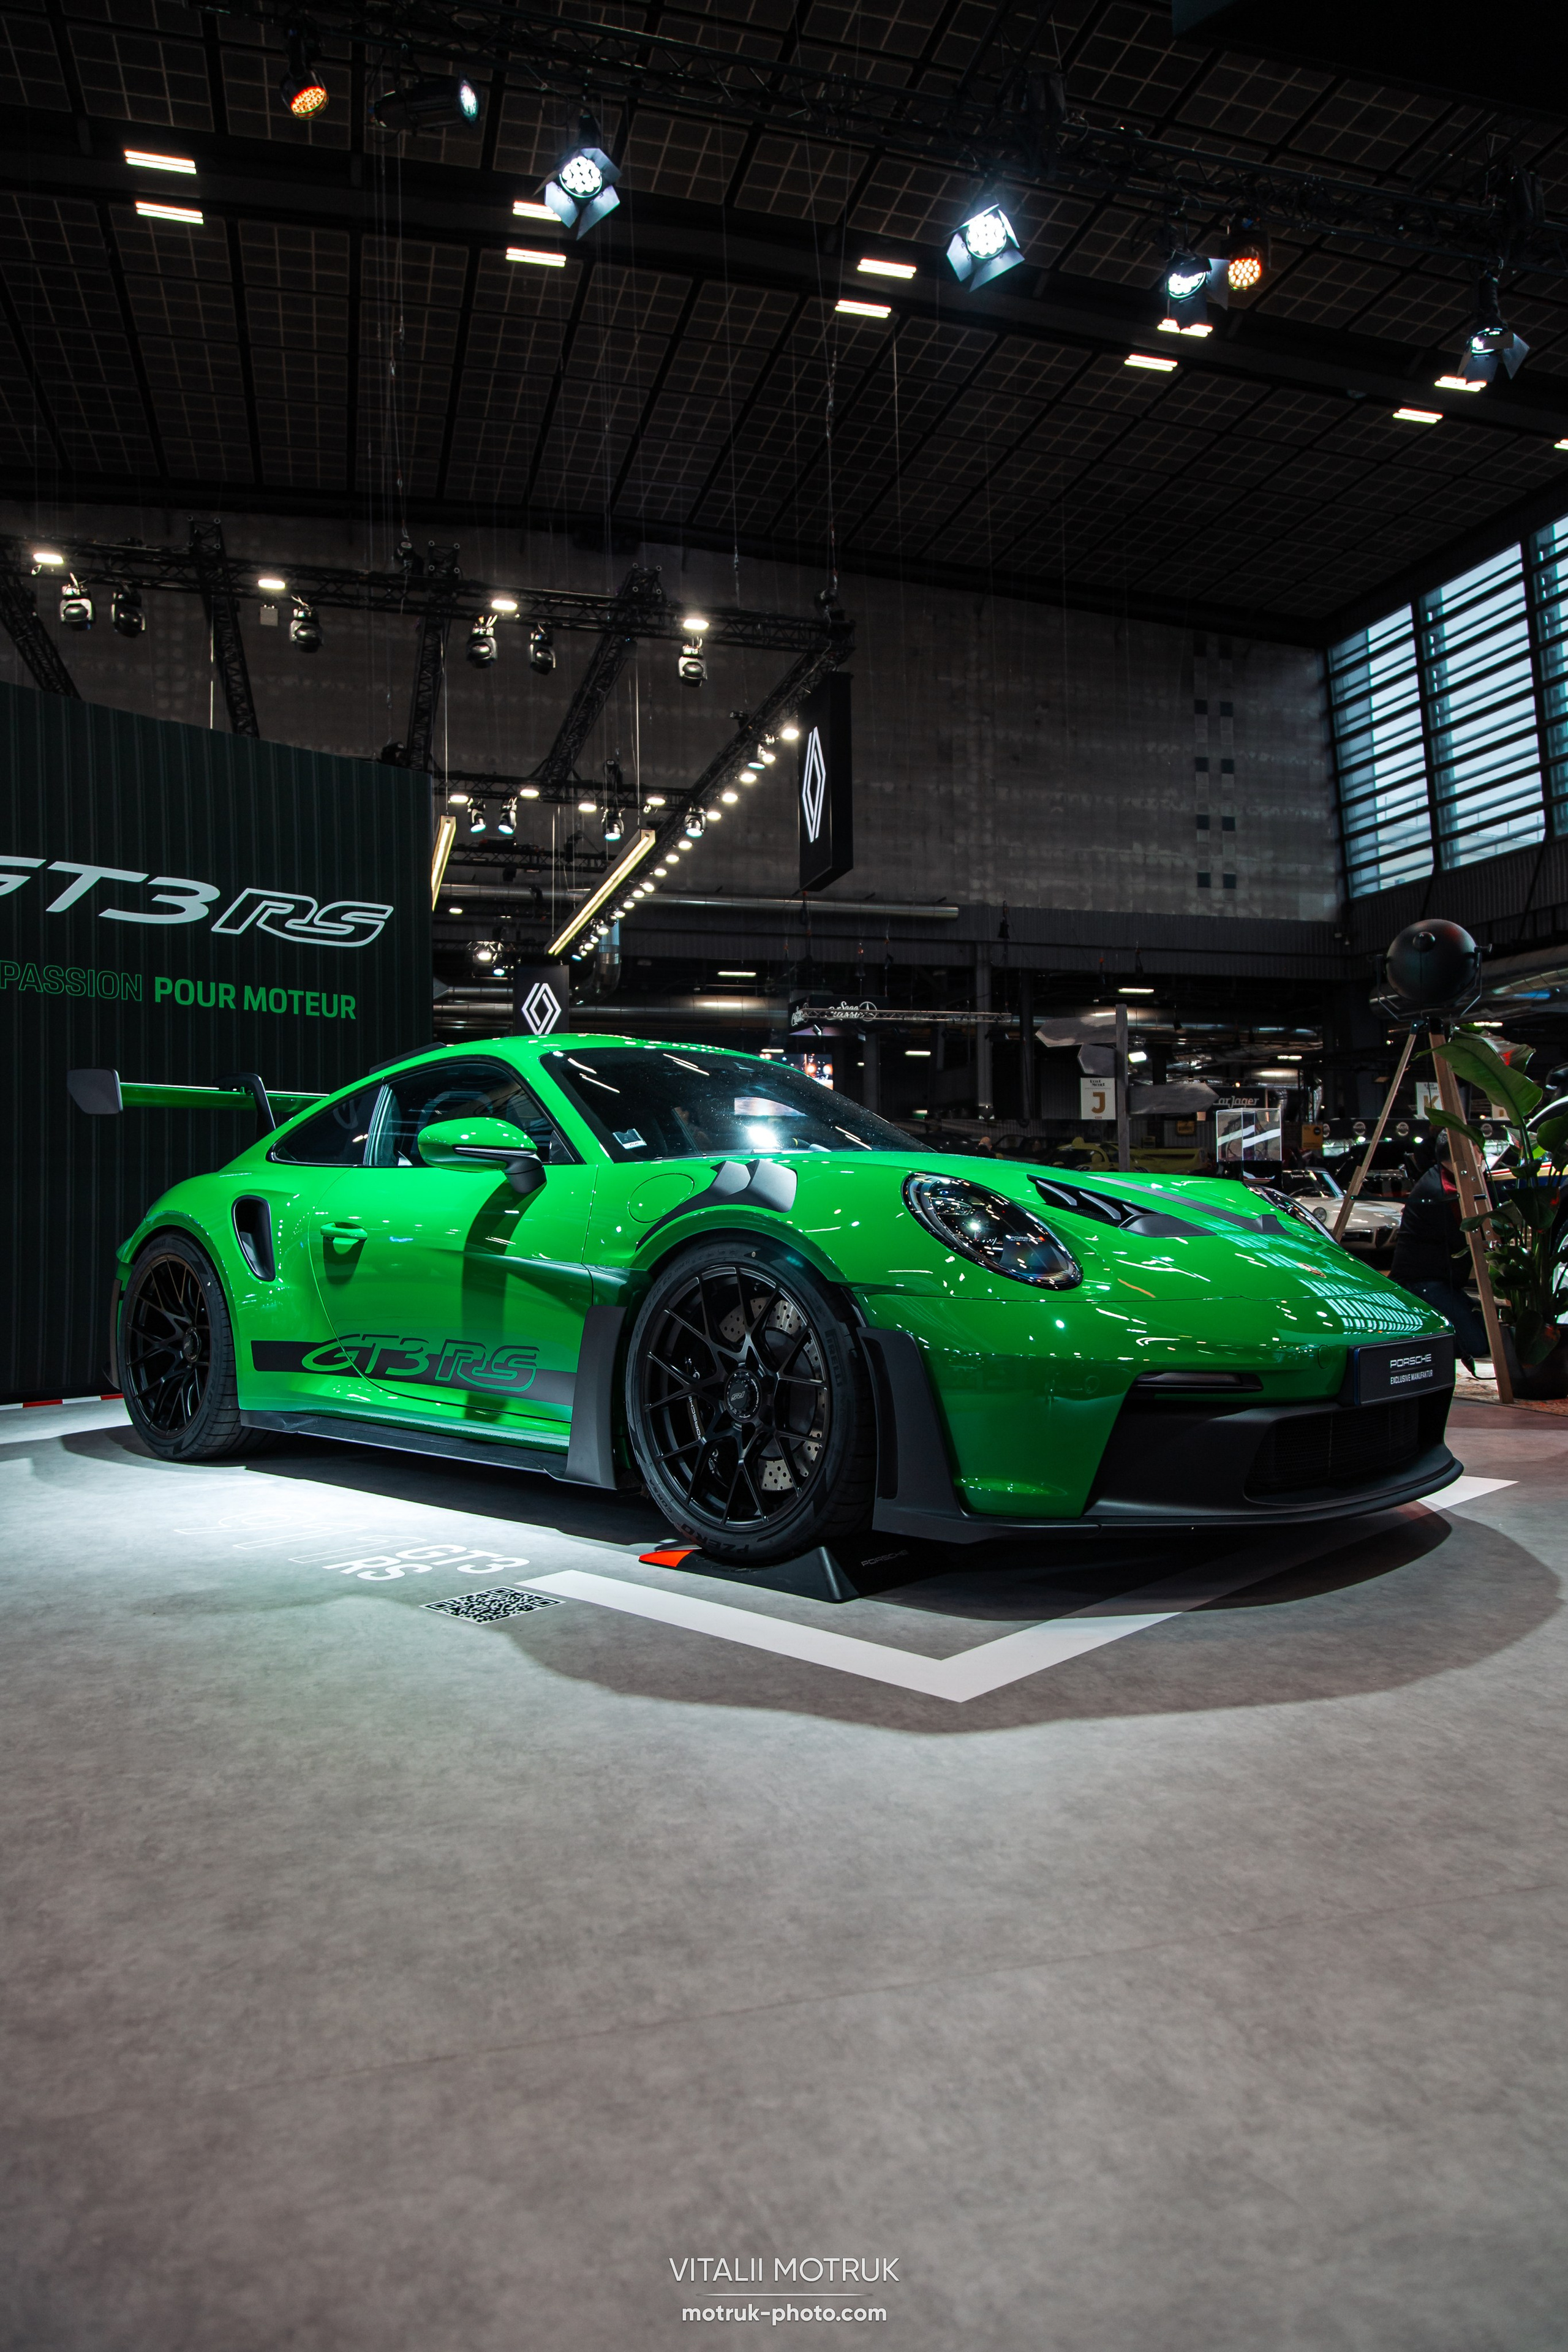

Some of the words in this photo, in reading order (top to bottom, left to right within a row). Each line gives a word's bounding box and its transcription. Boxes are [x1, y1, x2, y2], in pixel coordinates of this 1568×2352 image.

[0, 960, 142, 1001] PASSION
[155, 976, 236, 1009] POUR
[244, 986, 356, 1019] MOTEUR
[1091, 1091, 1106, 1114] J
[1213, 1096, 1259, 1109] arJager
[826, 1329, 844, 1387] PIRELLI
[1390, 1354, 1432, 1368] PORSCHE
[1390, 1374, 1411, 1384] EXCLUSIVE
[1411, 1370, 1433, 1381] MANUFAKTUR
[322, 1555, 433, 1581] RS
[395, 1544, 530, 1575] GT3
[861, 1550, 909, 1567] PORSCHE
